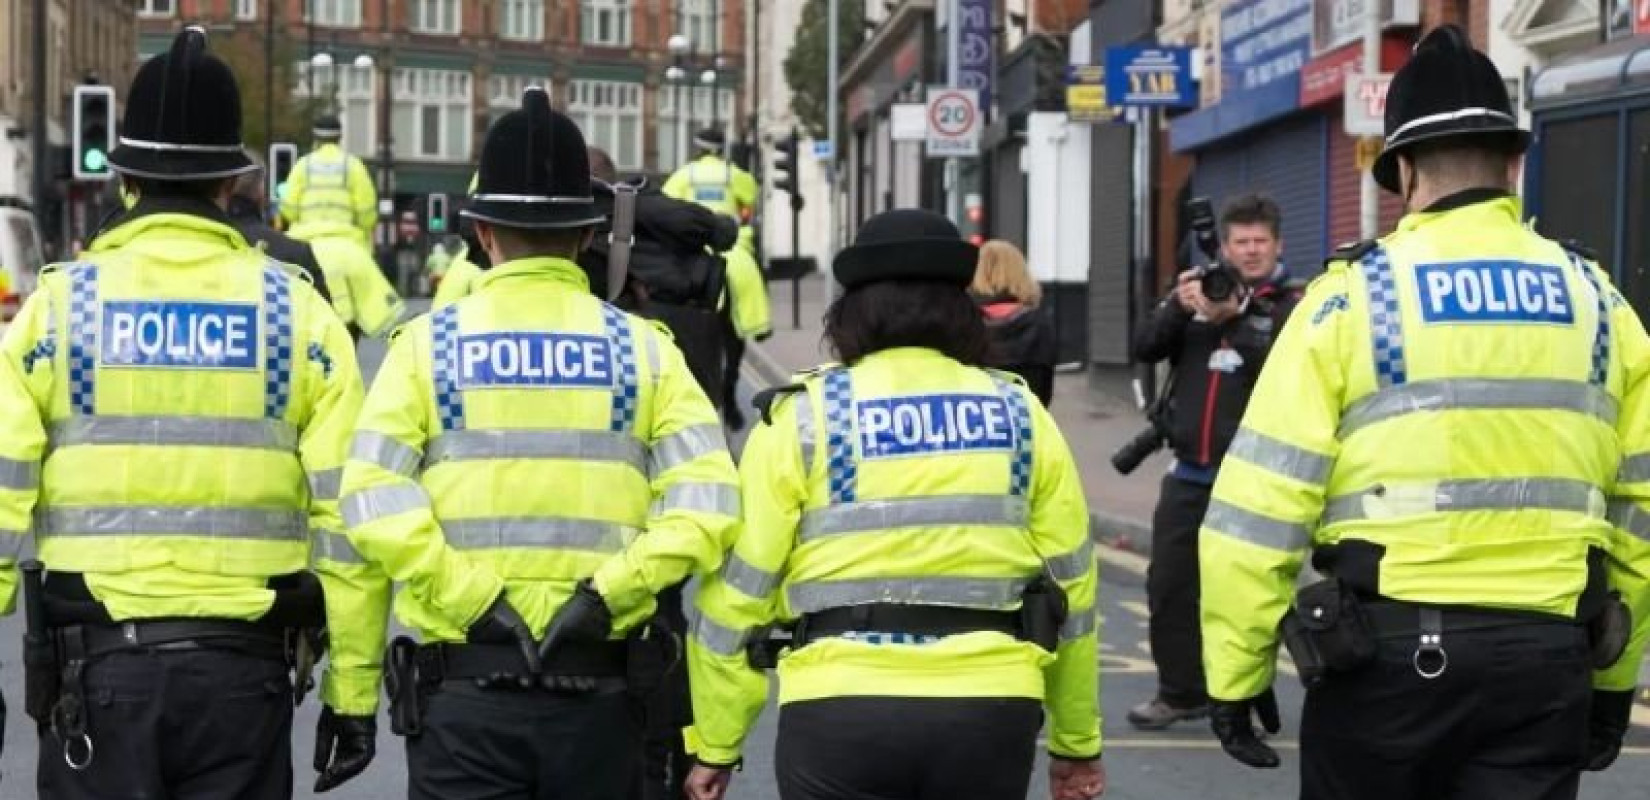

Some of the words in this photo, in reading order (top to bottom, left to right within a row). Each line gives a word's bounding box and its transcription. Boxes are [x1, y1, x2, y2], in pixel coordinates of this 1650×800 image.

[940, 105, 965, 122] 20
[1426, 267, 1567, 313] POLICE
[112, 312, 248, 357] POLICE
[461, 338, 607, 379] POLICE
[863, 401, 1007, 448] POLICE
